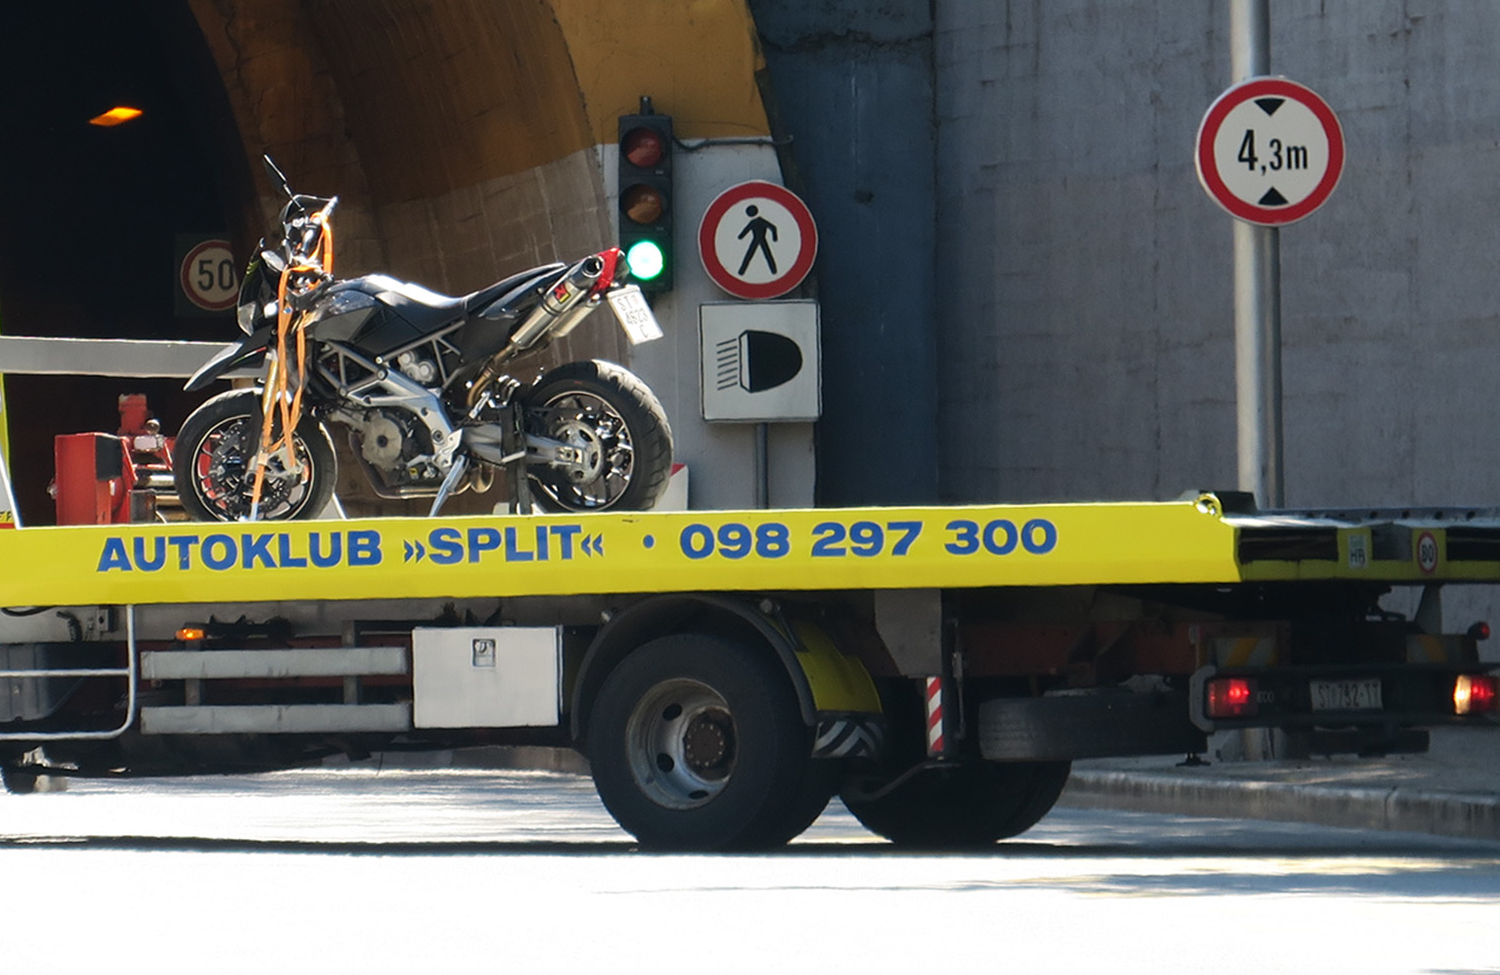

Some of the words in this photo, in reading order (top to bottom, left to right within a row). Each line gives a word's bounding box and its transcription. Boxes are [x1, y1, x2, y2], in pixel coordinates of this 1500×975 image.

[1237, 129, 1308, 176] 4,3m
[198, 259, 234, 291] 50
[96, 530, 381, 572] AUTOKLUB
[679, 523, 790, 559] 098
[811, 521, 923, 557] 297
[944, 519, 1057, 555] 300
